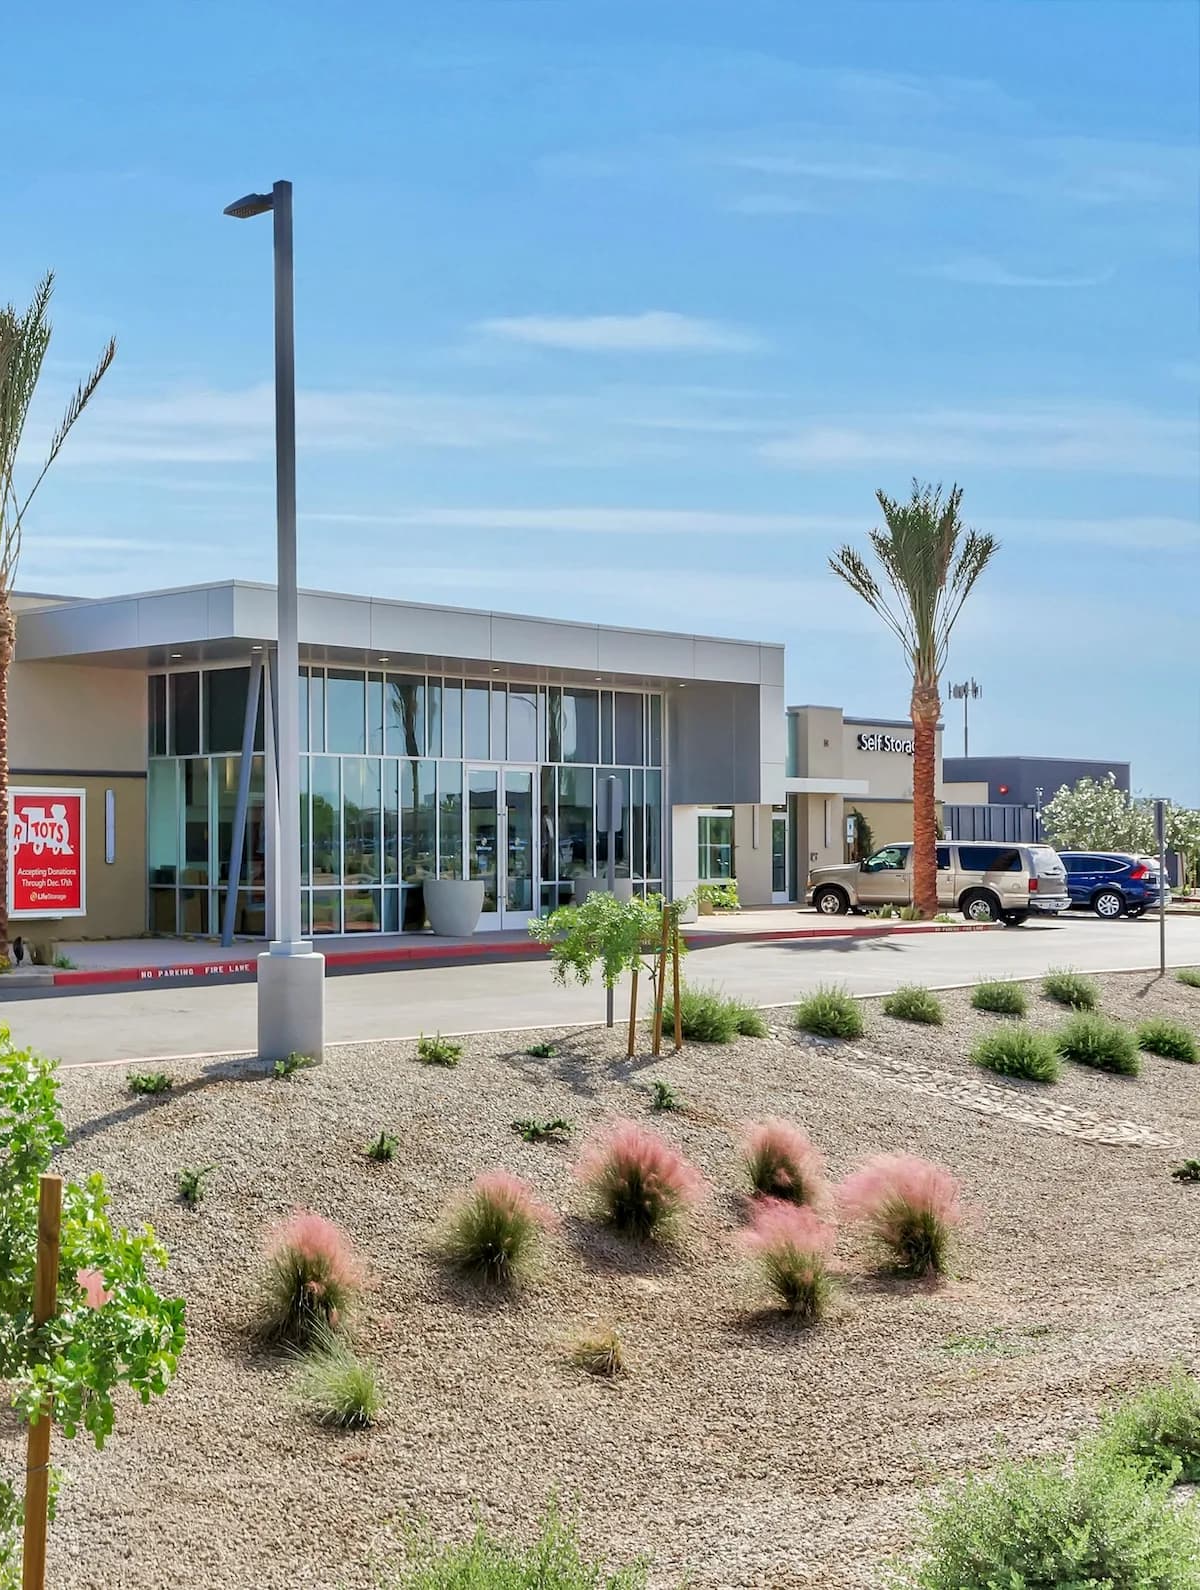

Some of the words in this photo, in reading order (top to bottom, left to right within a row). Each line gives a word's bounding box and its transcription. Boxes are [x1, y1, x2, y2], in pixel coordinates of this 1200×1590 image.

[861, 733, 882, 752] Self
[31, 822, 63, 843] TOTS
[17, 867, 47, 878] Accepting
[47, 867, 77, 877] Donations
[21, 878, 46, 889] Through
[46, 878, 60, 887] Dec.
[141, 970, 153, 979] NO
[158, 967, 194, 978] PARKING
[205, 965, 224, 975] FIRE
[229, 963, 250, 973] LANE
